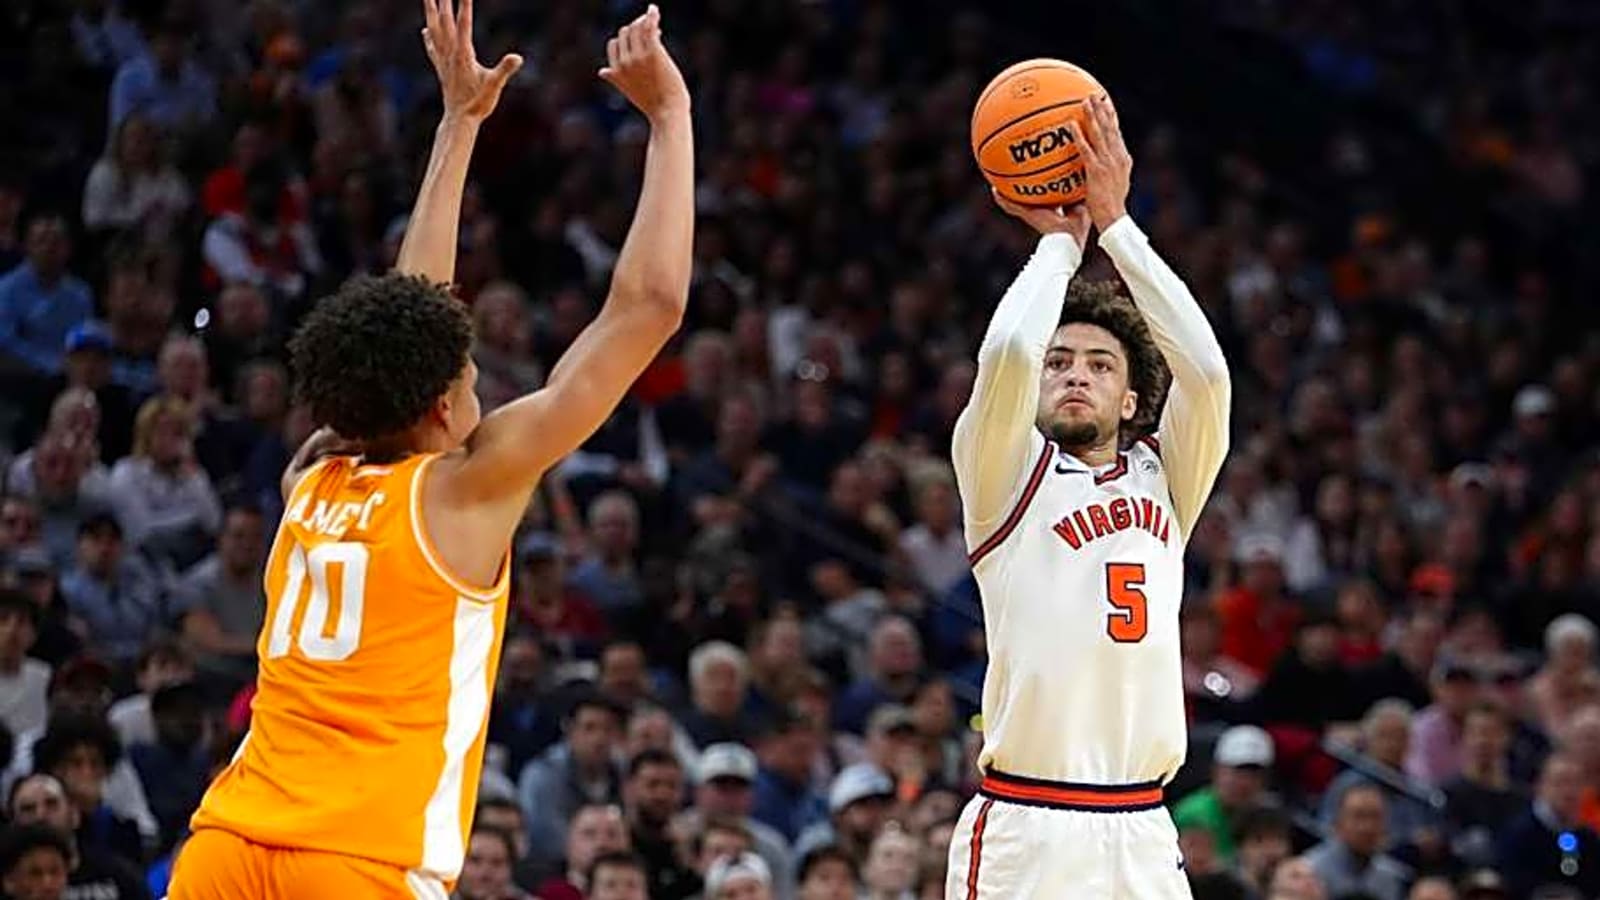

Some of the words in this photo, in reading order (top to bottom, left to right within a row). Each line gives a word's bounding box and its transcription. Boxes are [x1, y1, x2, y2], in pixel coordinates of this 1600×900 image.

[1009, 127, 1073, 163] NCAA
[1013, 164, 1086, 196] ilson
[268, 541, 369, 661] 10
[1105, 562, 1148, 643] 5
